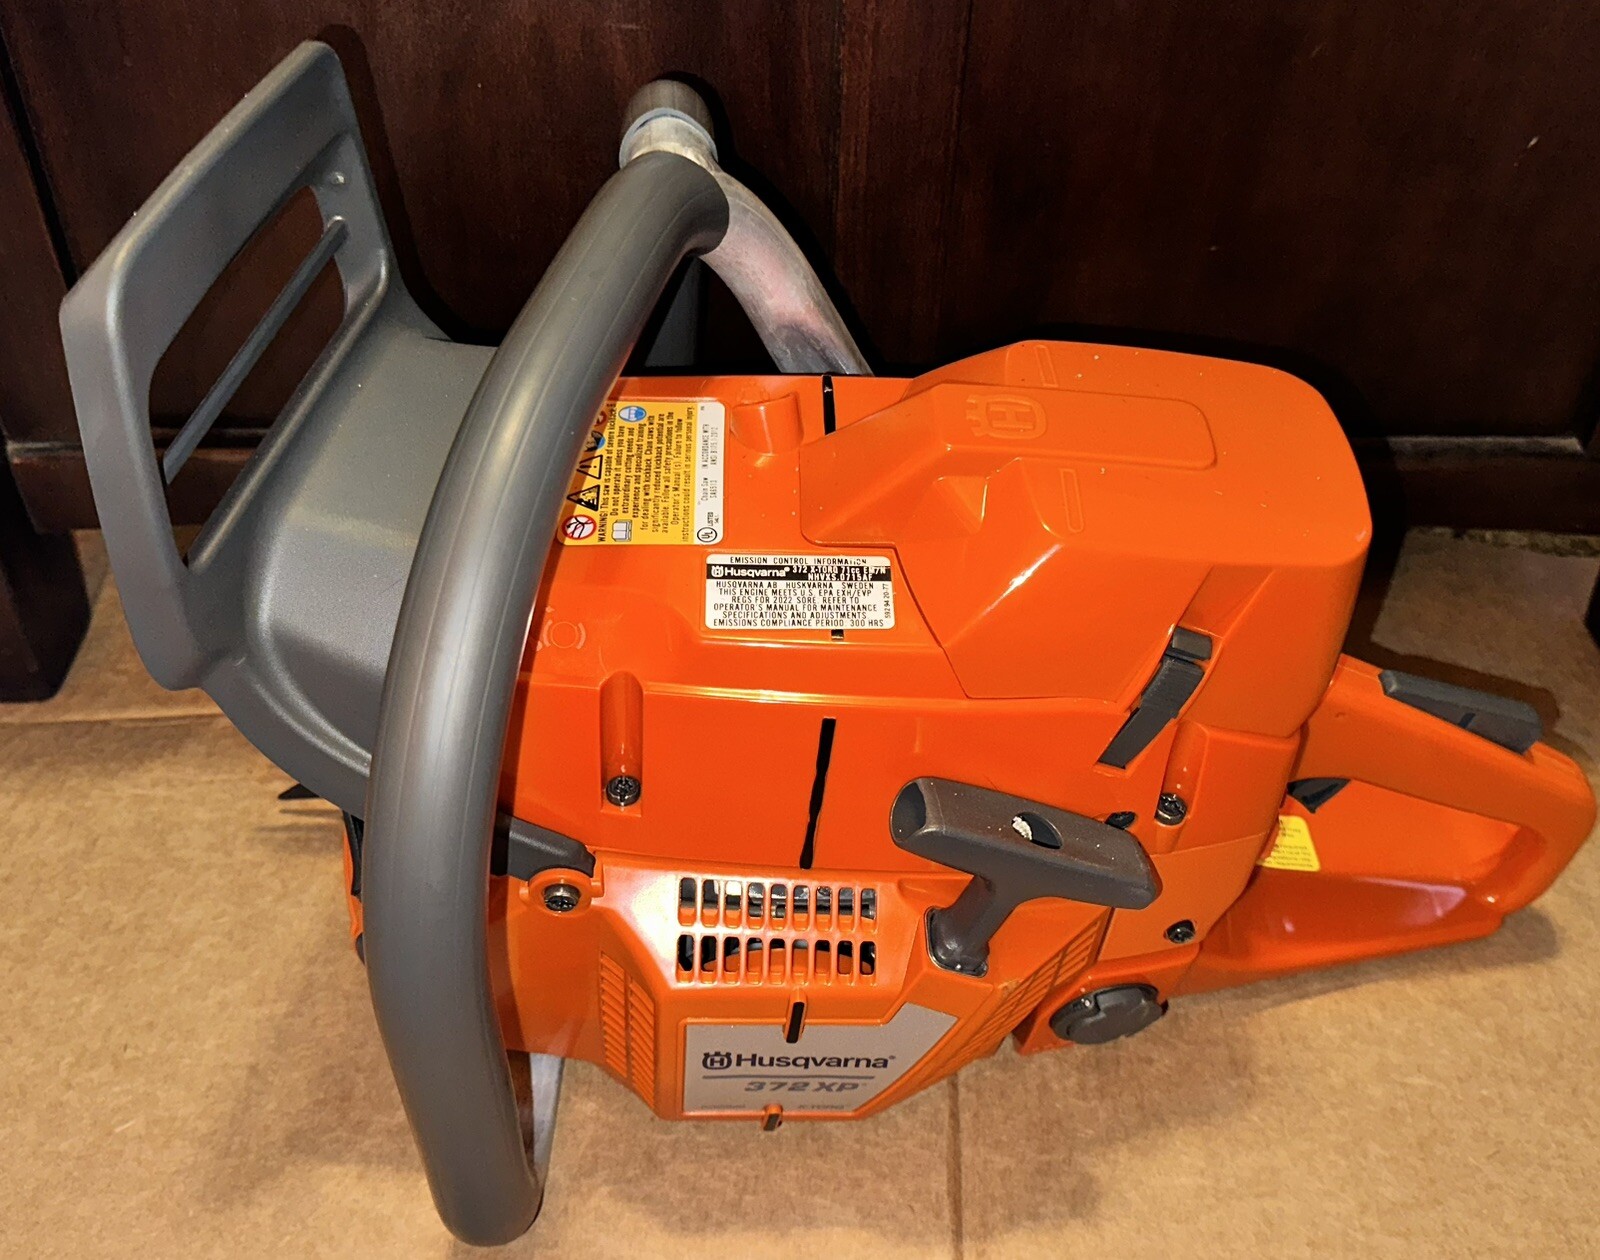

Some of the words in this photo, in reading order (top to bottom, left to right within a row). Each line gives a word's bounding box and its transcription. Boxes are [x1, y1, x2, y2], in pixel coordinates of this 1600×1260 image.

[666, 412, 674, 420] the
[617, 426, 625, 437] have
[636, 423, 646, 442] training
[656, 423, 664, 444] potential
[617, 439, 625, 447] you
[644, 441, 653, 455] Chain
[665, 427, 673, 455] precautions
[673, 441, 682, 458] Failure
[615, 449, 623, 466] unless
[625, 454, 634, 473] cutting
[634, 444, 643, 473] specialized
[654, 446, 662, 469] kickback
[604, 456, 612, 476] capable
[663, 457, 673, 474] safety
[612, 474, 621, 495] operate
[653, 471, 661, 493] reduced
[672, 472, 680, 491] Manual
[622, 475, 632, 513] extraordinary
[642, 484, 650, 496] with
[661, 485, 669, 502] Follow
[682, 488, 690, 503] could
[600, 498, 609, 509] This
[611, 497, 619, 506] not
[632, 487, 640, 518] experience
[641, 498, 651, 519] dealing
[610, 508, 618, 516] Do
[652, 495, 661, 532] significantly
[670, 494, 680, 525] Operator's
[598, 511, 608, 542] WARNING!
[640, 521, 648, 530] for
[730, 556, 768, 564] EMISSION
[773, 557, 808, 565] CONTROL
[724, 567, 787, 577] Husqvarna
[792, 565, 807, 573] 372
[841, 566, 860, 574] 71cc
[807, 573, 872, 581] NHVXS.0715AF
[785, 581, 833, 589] HUSKVARNA
[739, 588, 768, 596] ENGINE
[771, 588, 797, 596] MEETS
[818, 589, 834, 597] EPA
[836, 589, 872, 598] EXH/EVP
[713, 603, 763, 611] OPERATOR'S
[820, 604, 877, 612] MAINTENANCE
[722, 611, 788, 619] SPECIFICATIONS
[790, 611, 807, 619] AND
[713, 619, 757, 627] EMISSIONS
[760, 619, 813, 627] COMPLIANCE
[850, 619, 865, 627] 300
[735, 1054, 887, 1069] Husqvarna
[744, 1081, 810, 1092] 372
[812, 1081, 859, 1092] XP
